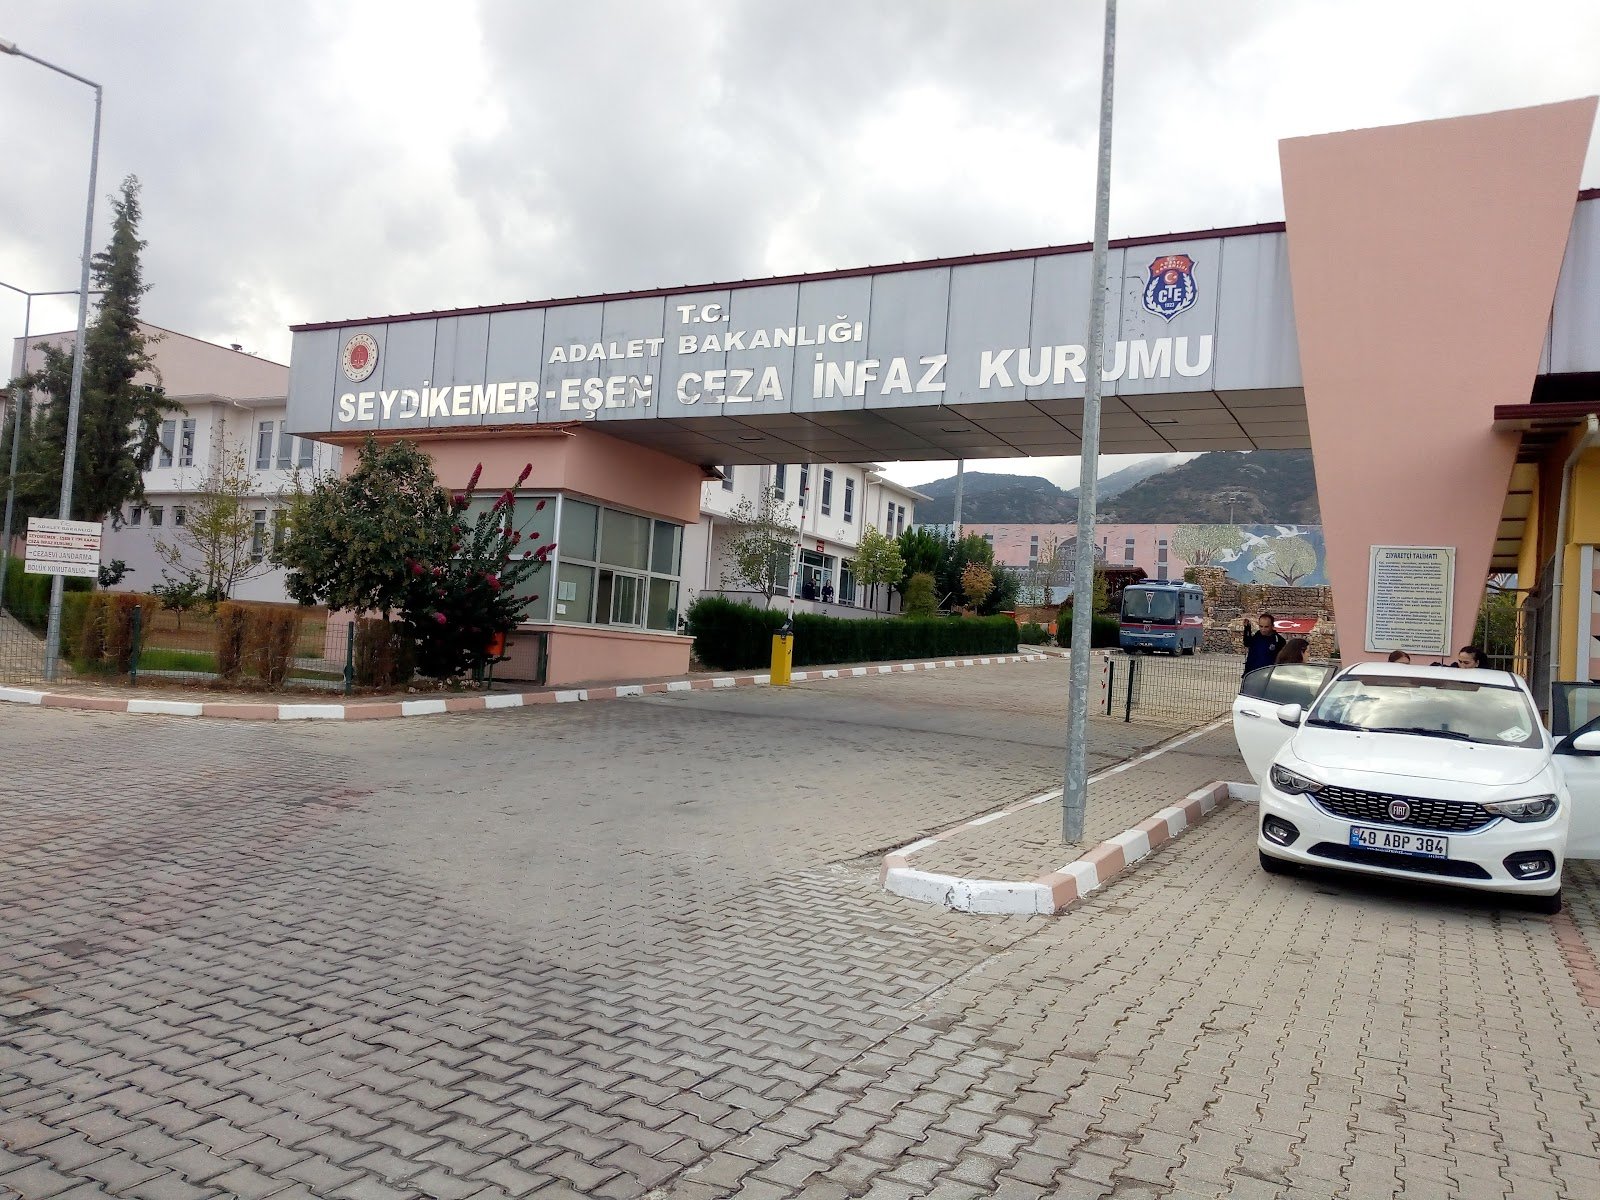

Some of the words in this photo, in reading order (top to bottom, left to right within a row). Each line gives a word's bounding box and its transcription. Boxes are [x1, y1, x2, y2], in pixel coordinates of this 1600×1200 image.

[676, 303, 730, 324] T.C.
[548, 337, 665, 364] ADALET
[678, 314, 863, 355] BAKANLIĞI
[676, 366, 785, 405] CEZA
[813, 352, 948, 399] İNFAZ
[979, 335, 1213, 389] KURUMU
[58, 552, 92, 560] JANDARMA
[1393, 806, 1406, 816] FIAT
[1384, 833, 1410, 849] ABP
[1416, 837, 1443, 854] 384
